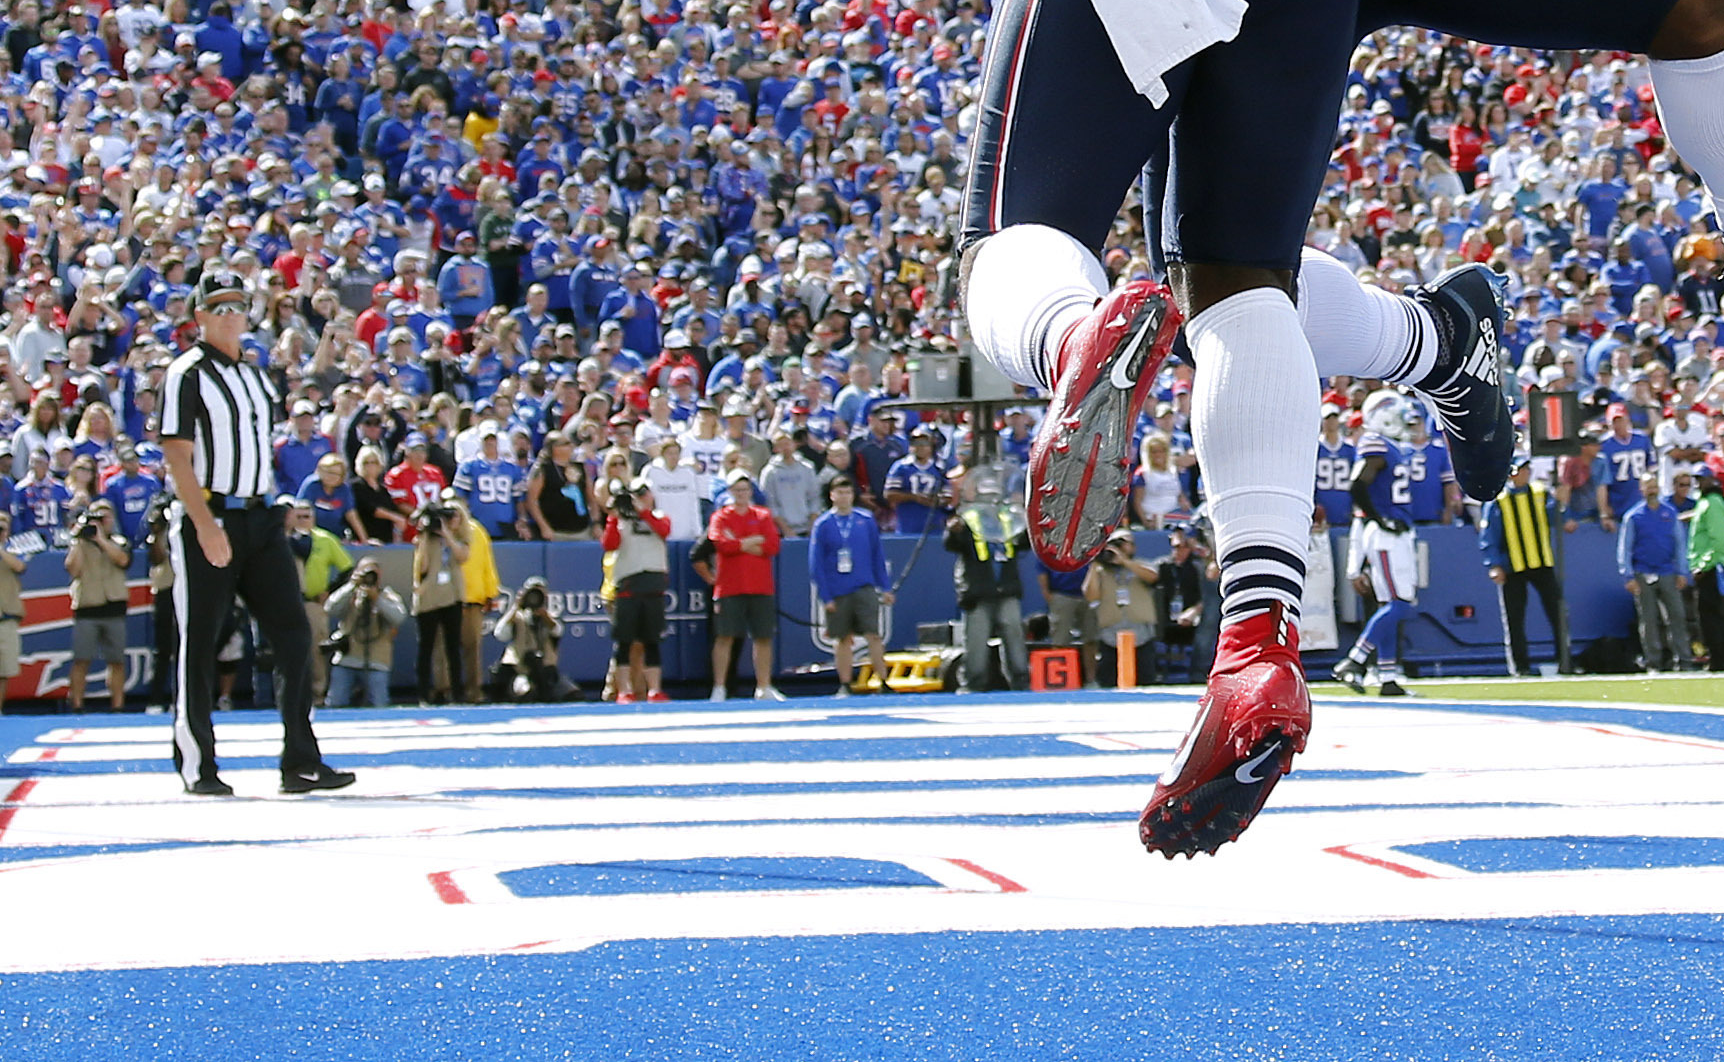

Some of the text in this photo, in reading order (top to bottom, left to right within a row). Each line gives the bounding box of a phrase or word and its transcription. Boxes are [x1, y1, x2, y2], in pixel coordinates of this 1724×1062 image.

[1543, 395, 1563, 441] 1
[694, 451, 723, 474] 55
[1317, 457, 1350, 491] 92
[1613, 451, 1645, 482] 78
[478, 473, 513, 505] 99
[907, 473, 935, 496] 17
[1391, 463, 1412, 505] 2
[1041, 655, 1069, 686] G
